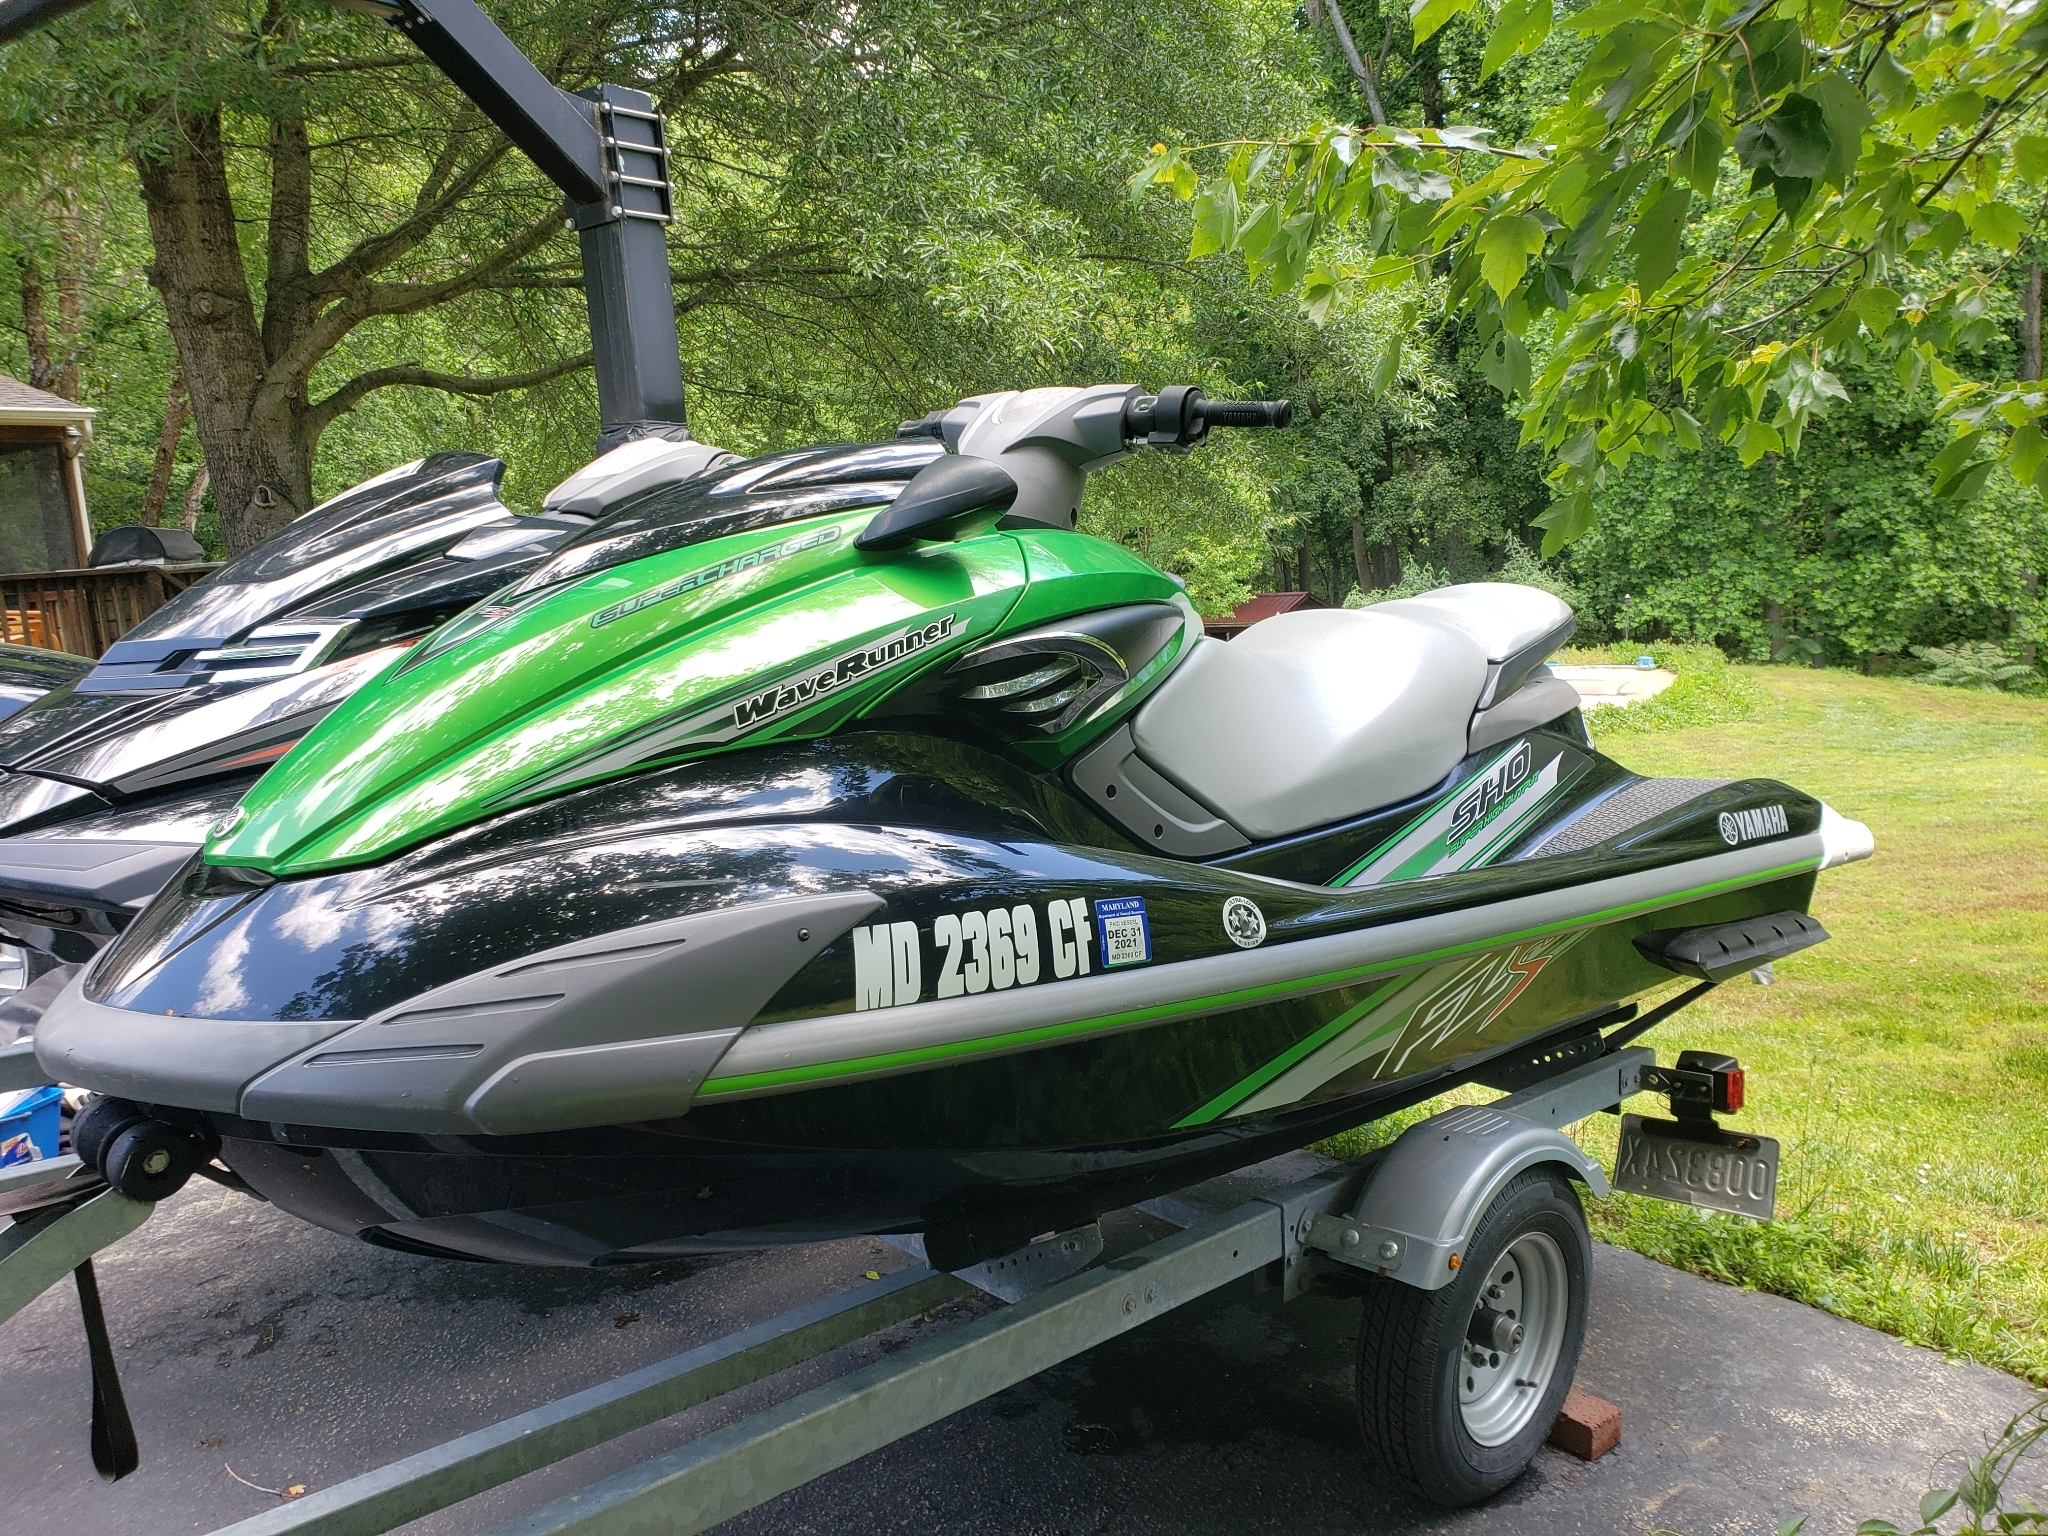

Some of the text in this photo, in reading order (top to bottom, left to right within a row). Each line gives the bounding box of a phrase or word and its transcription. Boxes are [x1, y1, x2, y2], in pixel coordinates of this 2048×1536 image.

[1223, 411, 1257, 422] YAMAHA
[594, 526, 841, 625] SUPERCHARGED
[733, 613, 957, 729] WaveRunner
[1447, 742, 1532, 846] SHO
[1448, 769, 1541, 859] SUPER HIGH OUTPUT
[1733, 804, 1790, 841] YAMAHA
[1101, 900, 1140, 912] MARYLAND
[1108, 926, 1142, 940] DEC 31
[1114, 938, 1138, 950] 2021
[853, 897, 1093, 1012] MD 2369 CF
[1111, 952, 1121, 961] MD
[1134, 950, 1142, 958] CF
